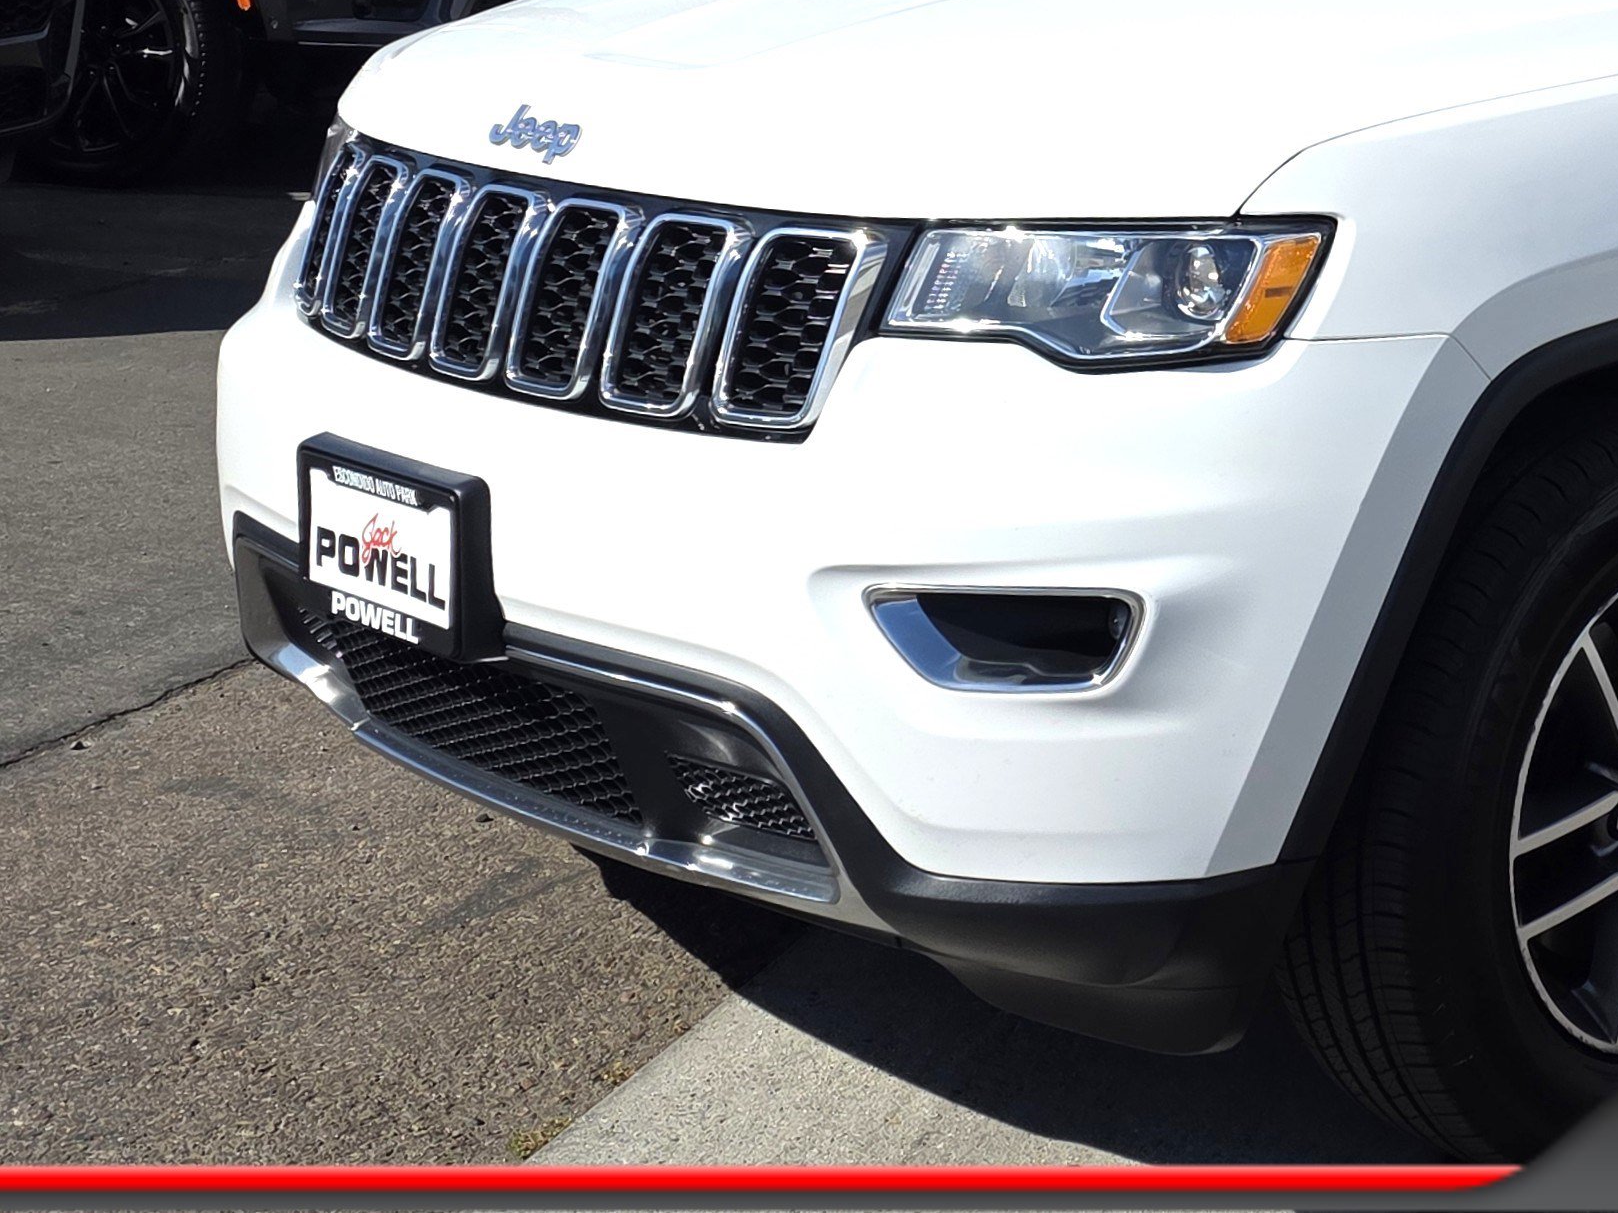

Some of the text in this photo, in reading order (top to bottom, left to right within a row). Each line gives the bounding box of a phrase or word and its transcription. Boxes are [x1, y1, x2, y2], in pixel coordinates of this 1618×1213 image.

[489, 104, 582, 165] Jeep
[361, 513, 402, 564] Jack
[316, 525, 446, 611] POWELL
[331, 590, 419, 645] POWELL
